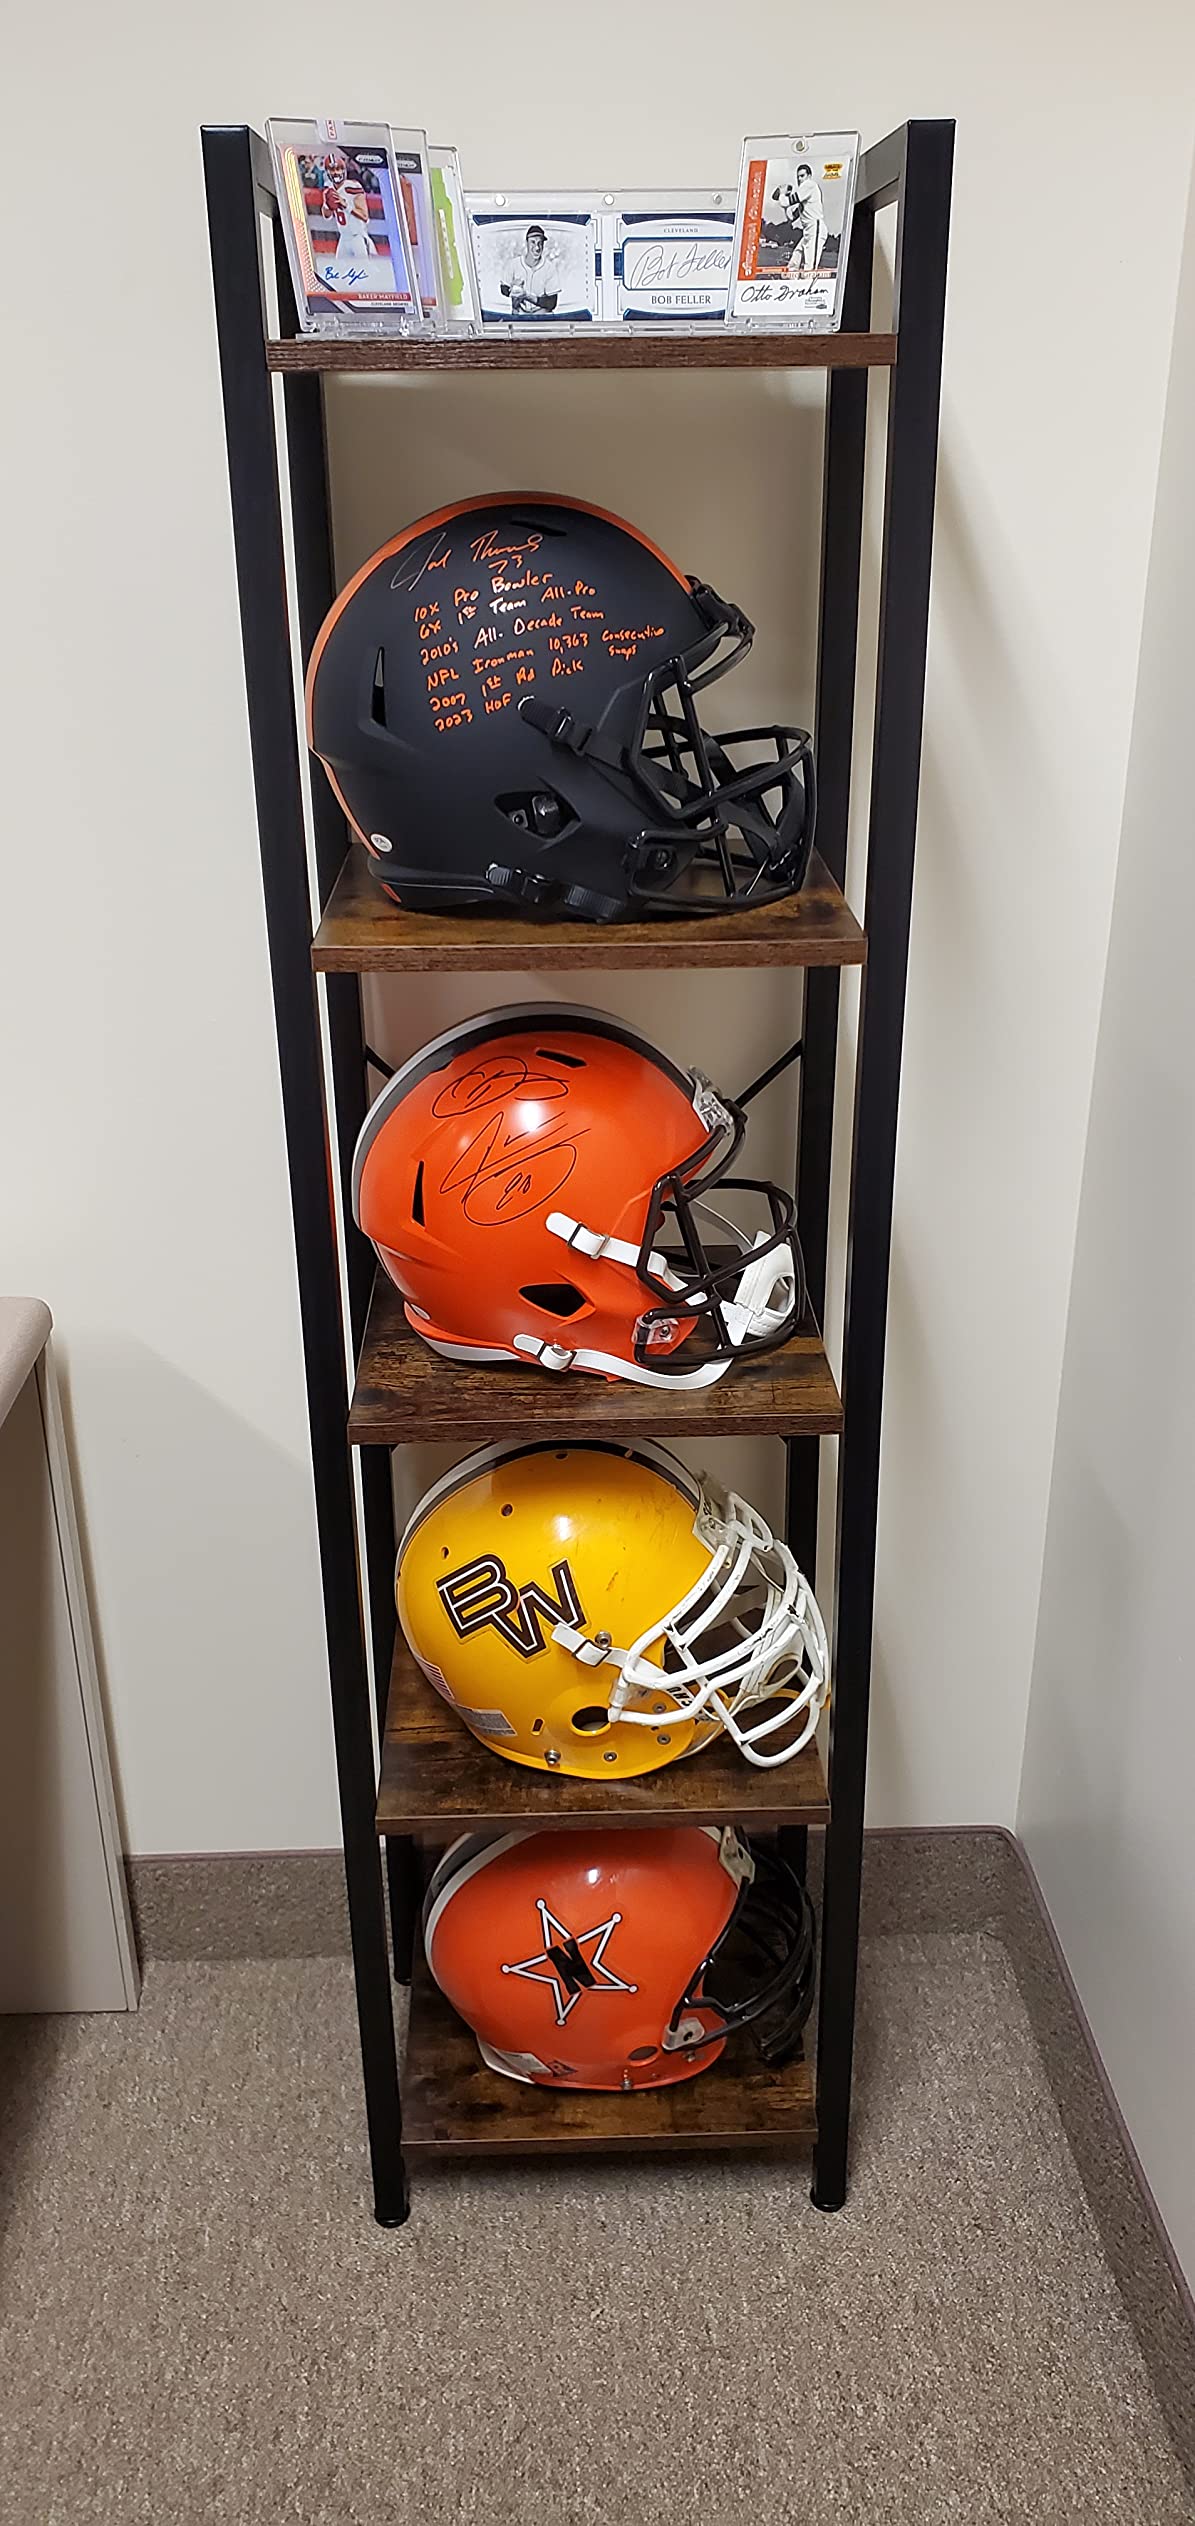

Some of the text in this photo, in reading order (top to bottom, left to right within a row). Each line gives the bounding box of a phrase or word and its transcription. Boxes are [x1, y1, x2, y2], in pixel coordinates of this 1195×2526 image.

[651, 295, 711, 304] BOB FELLER
[740, 284, 773, 302] Otto
[454, 587, 479, 607] Pro
[491, 569, 553, 593] Bowler
[489, 597, 527, 614] Team
[570, 605, 605, 620] Team
[427, 667, 460, 691] NFL
[472, 649, 534, 674] Ironman
[548, 633, 590, 654] 10,363
[429, 692, 466, 711] 2007
[434, 708, 474, 731] 2023
[436, 1553, 588, 1659] BW
[547, 1938, 597, 1996] N
